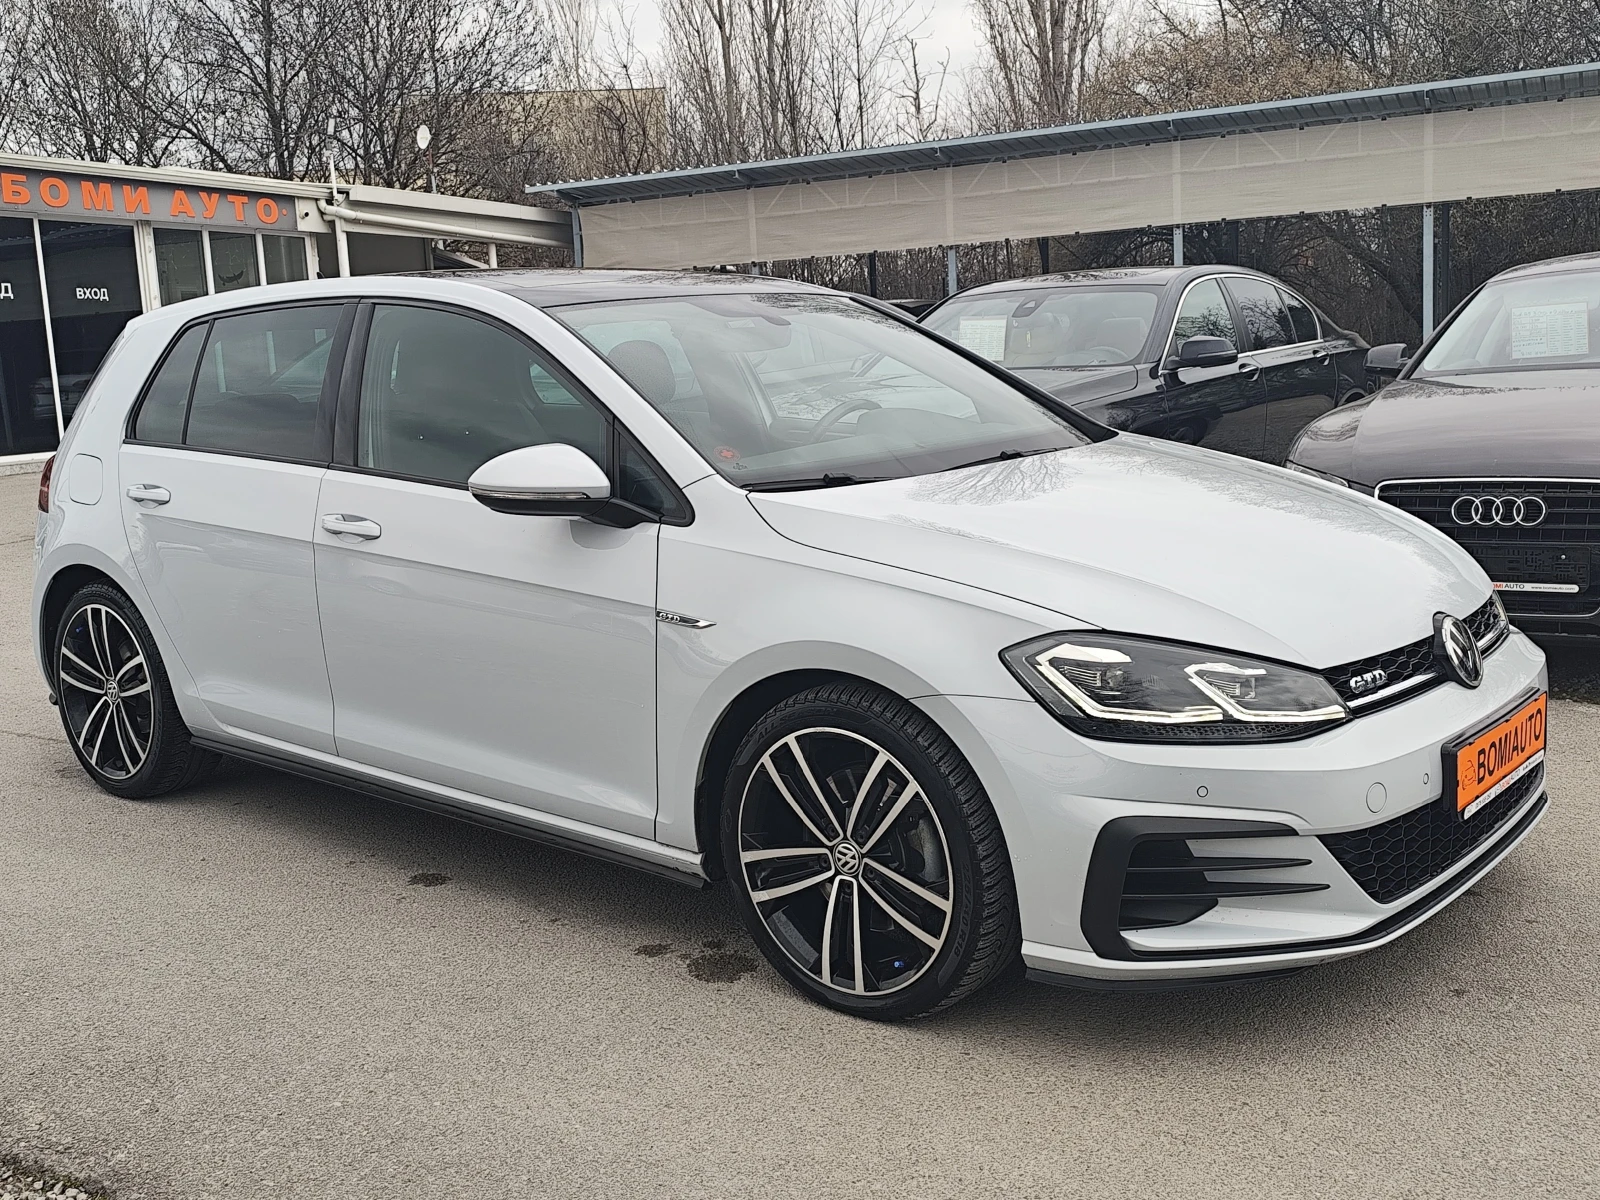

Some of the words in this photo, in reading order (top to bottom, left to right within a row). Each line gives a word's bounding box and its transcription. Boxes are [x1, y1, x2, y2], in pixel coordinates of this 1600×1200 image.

[0, 172, 150, 214] БОМИ
[170, 189, 280, 224] АУТО
[75, 287, 109, 302] ВХОД
[659, 612, 680, 623] GTD
[1350, 669, 1387, 693] GTD
[1477, 708, 1543, 785] BOMIAUTO
